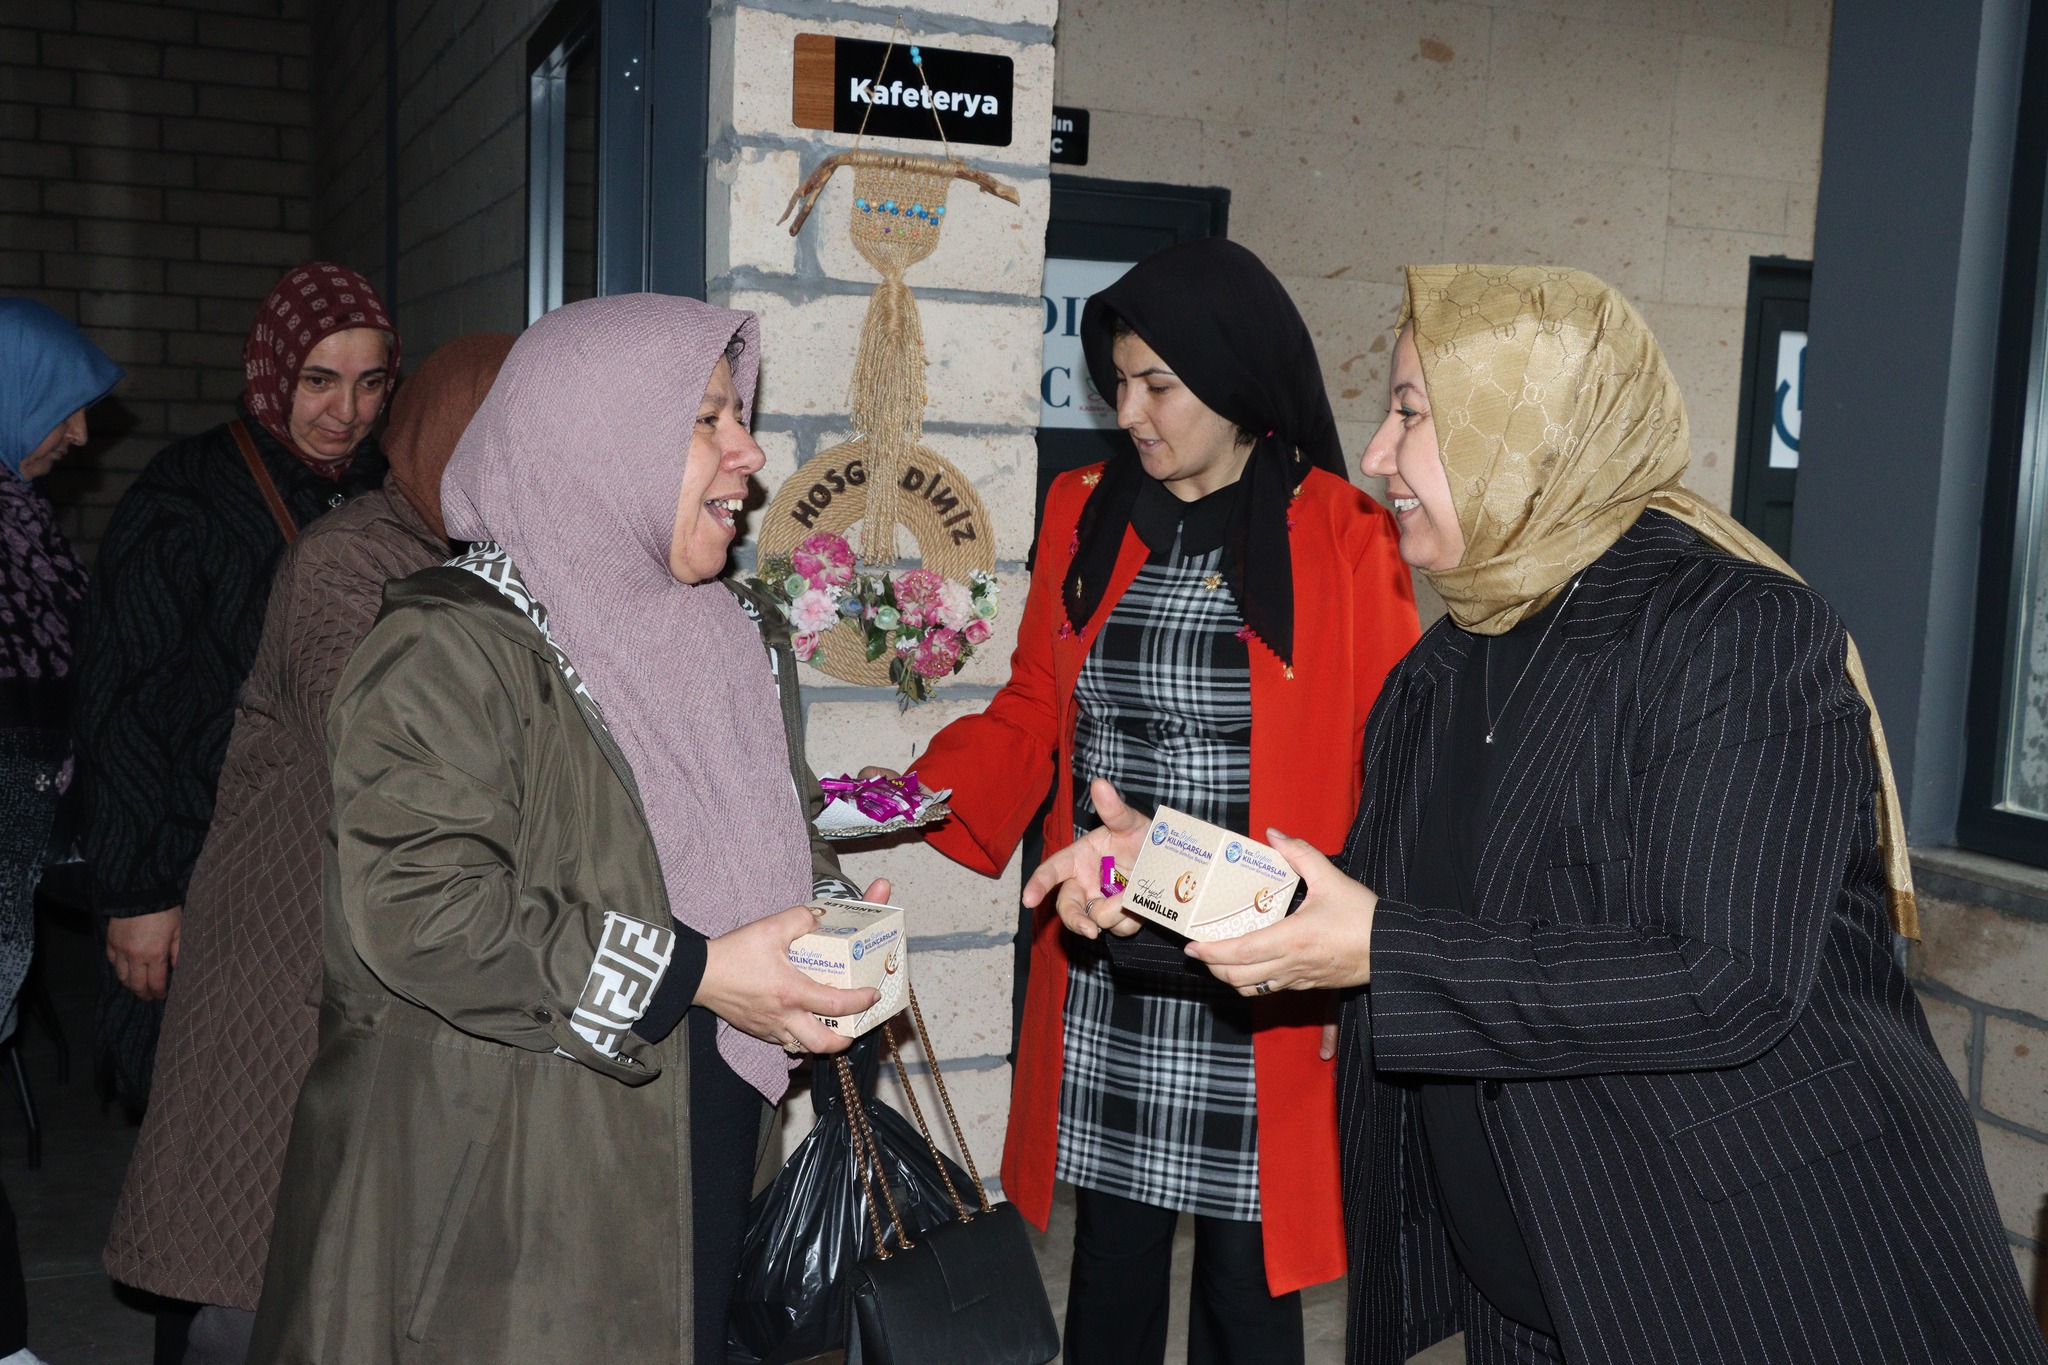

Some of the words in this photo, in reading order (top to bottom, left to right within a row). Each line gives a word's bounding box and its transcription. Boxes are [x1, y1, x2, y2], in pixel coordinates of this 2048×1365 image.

[850, 77, 999, 119] Kafeterya
[1166, 835, 1213, 860] KILINÇARSLAN
[1242, 855, 1288, 878] KILINÇARSLAN
[1132, 892, 1179, 922] KANDİLLER
[788, 955, 845, 970] KILINÇARSLAN
